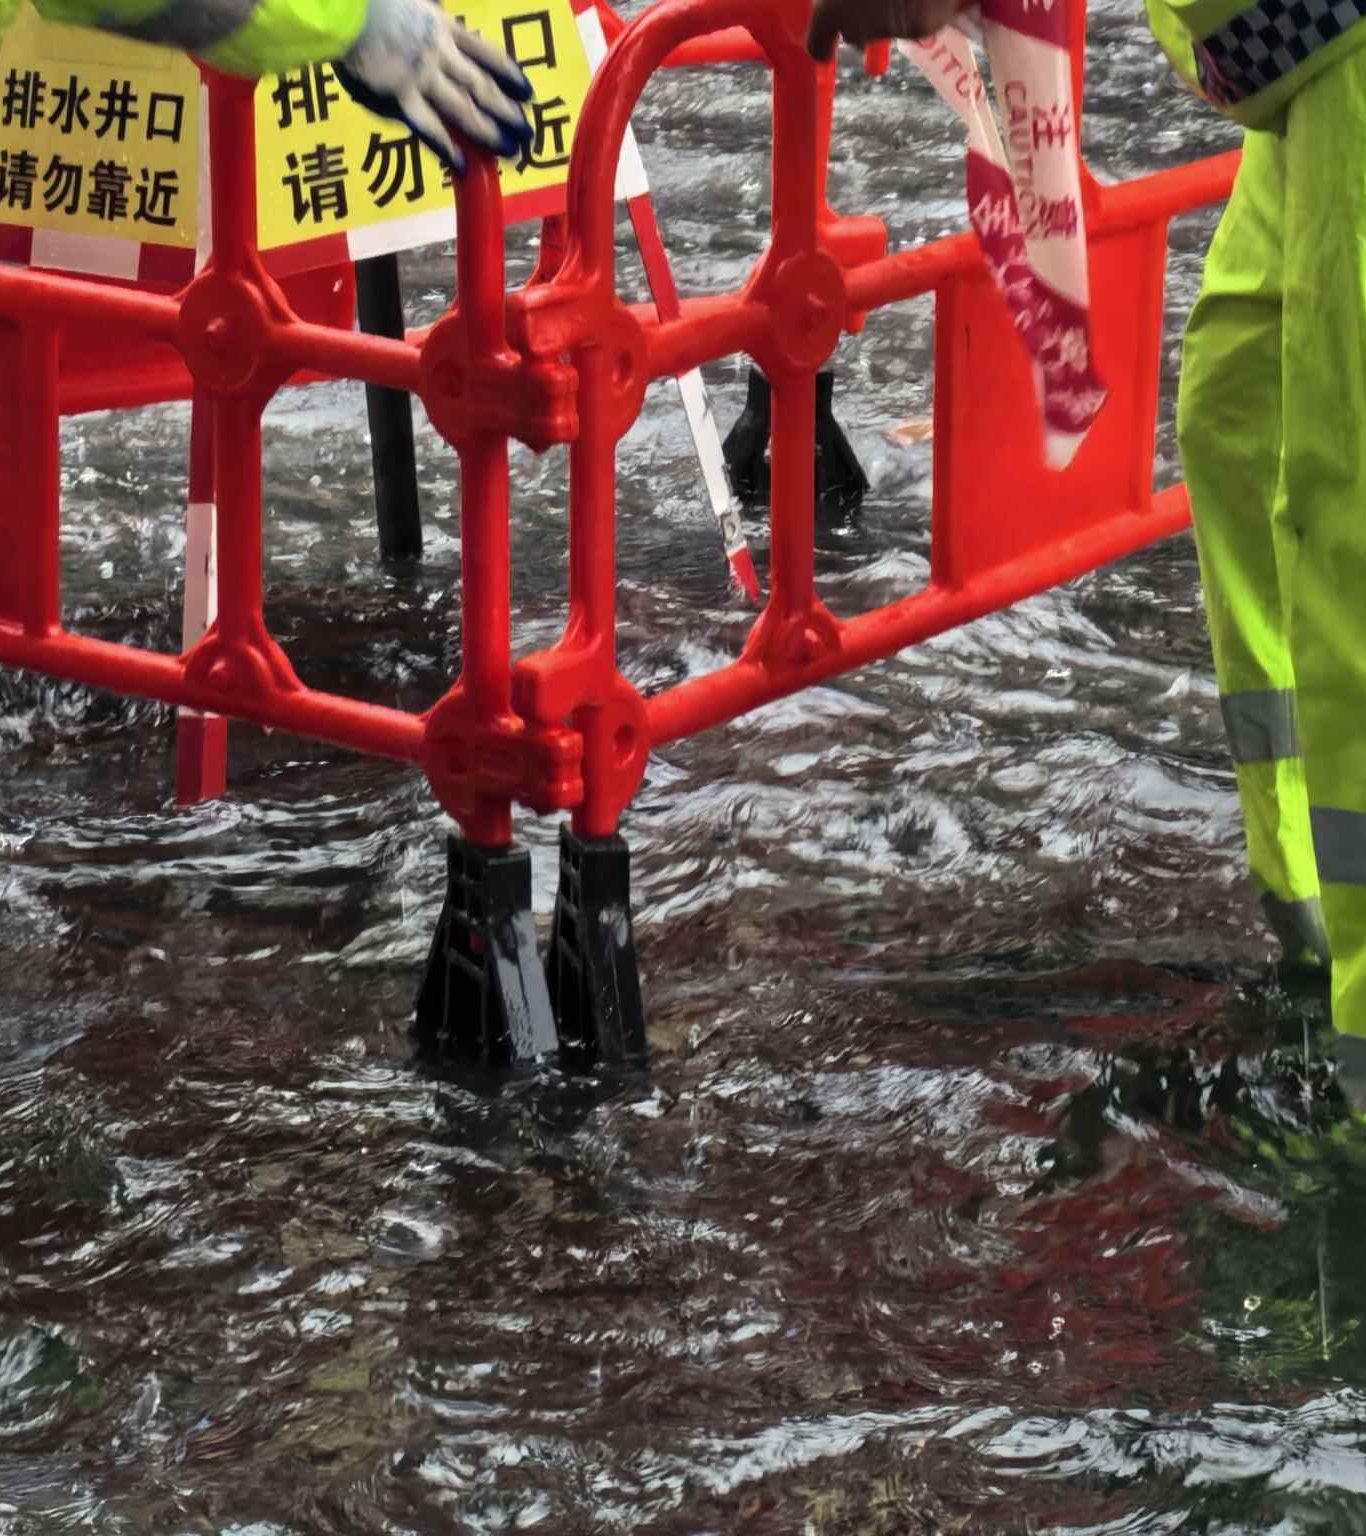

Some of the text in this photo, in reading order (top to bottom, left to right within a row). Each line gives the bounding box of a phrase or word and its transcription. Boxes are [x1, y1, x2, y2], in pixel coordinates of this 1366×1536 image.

[2, 68, 184, 142] 排水井口
[281, 96, 572, 226] 请勿近
